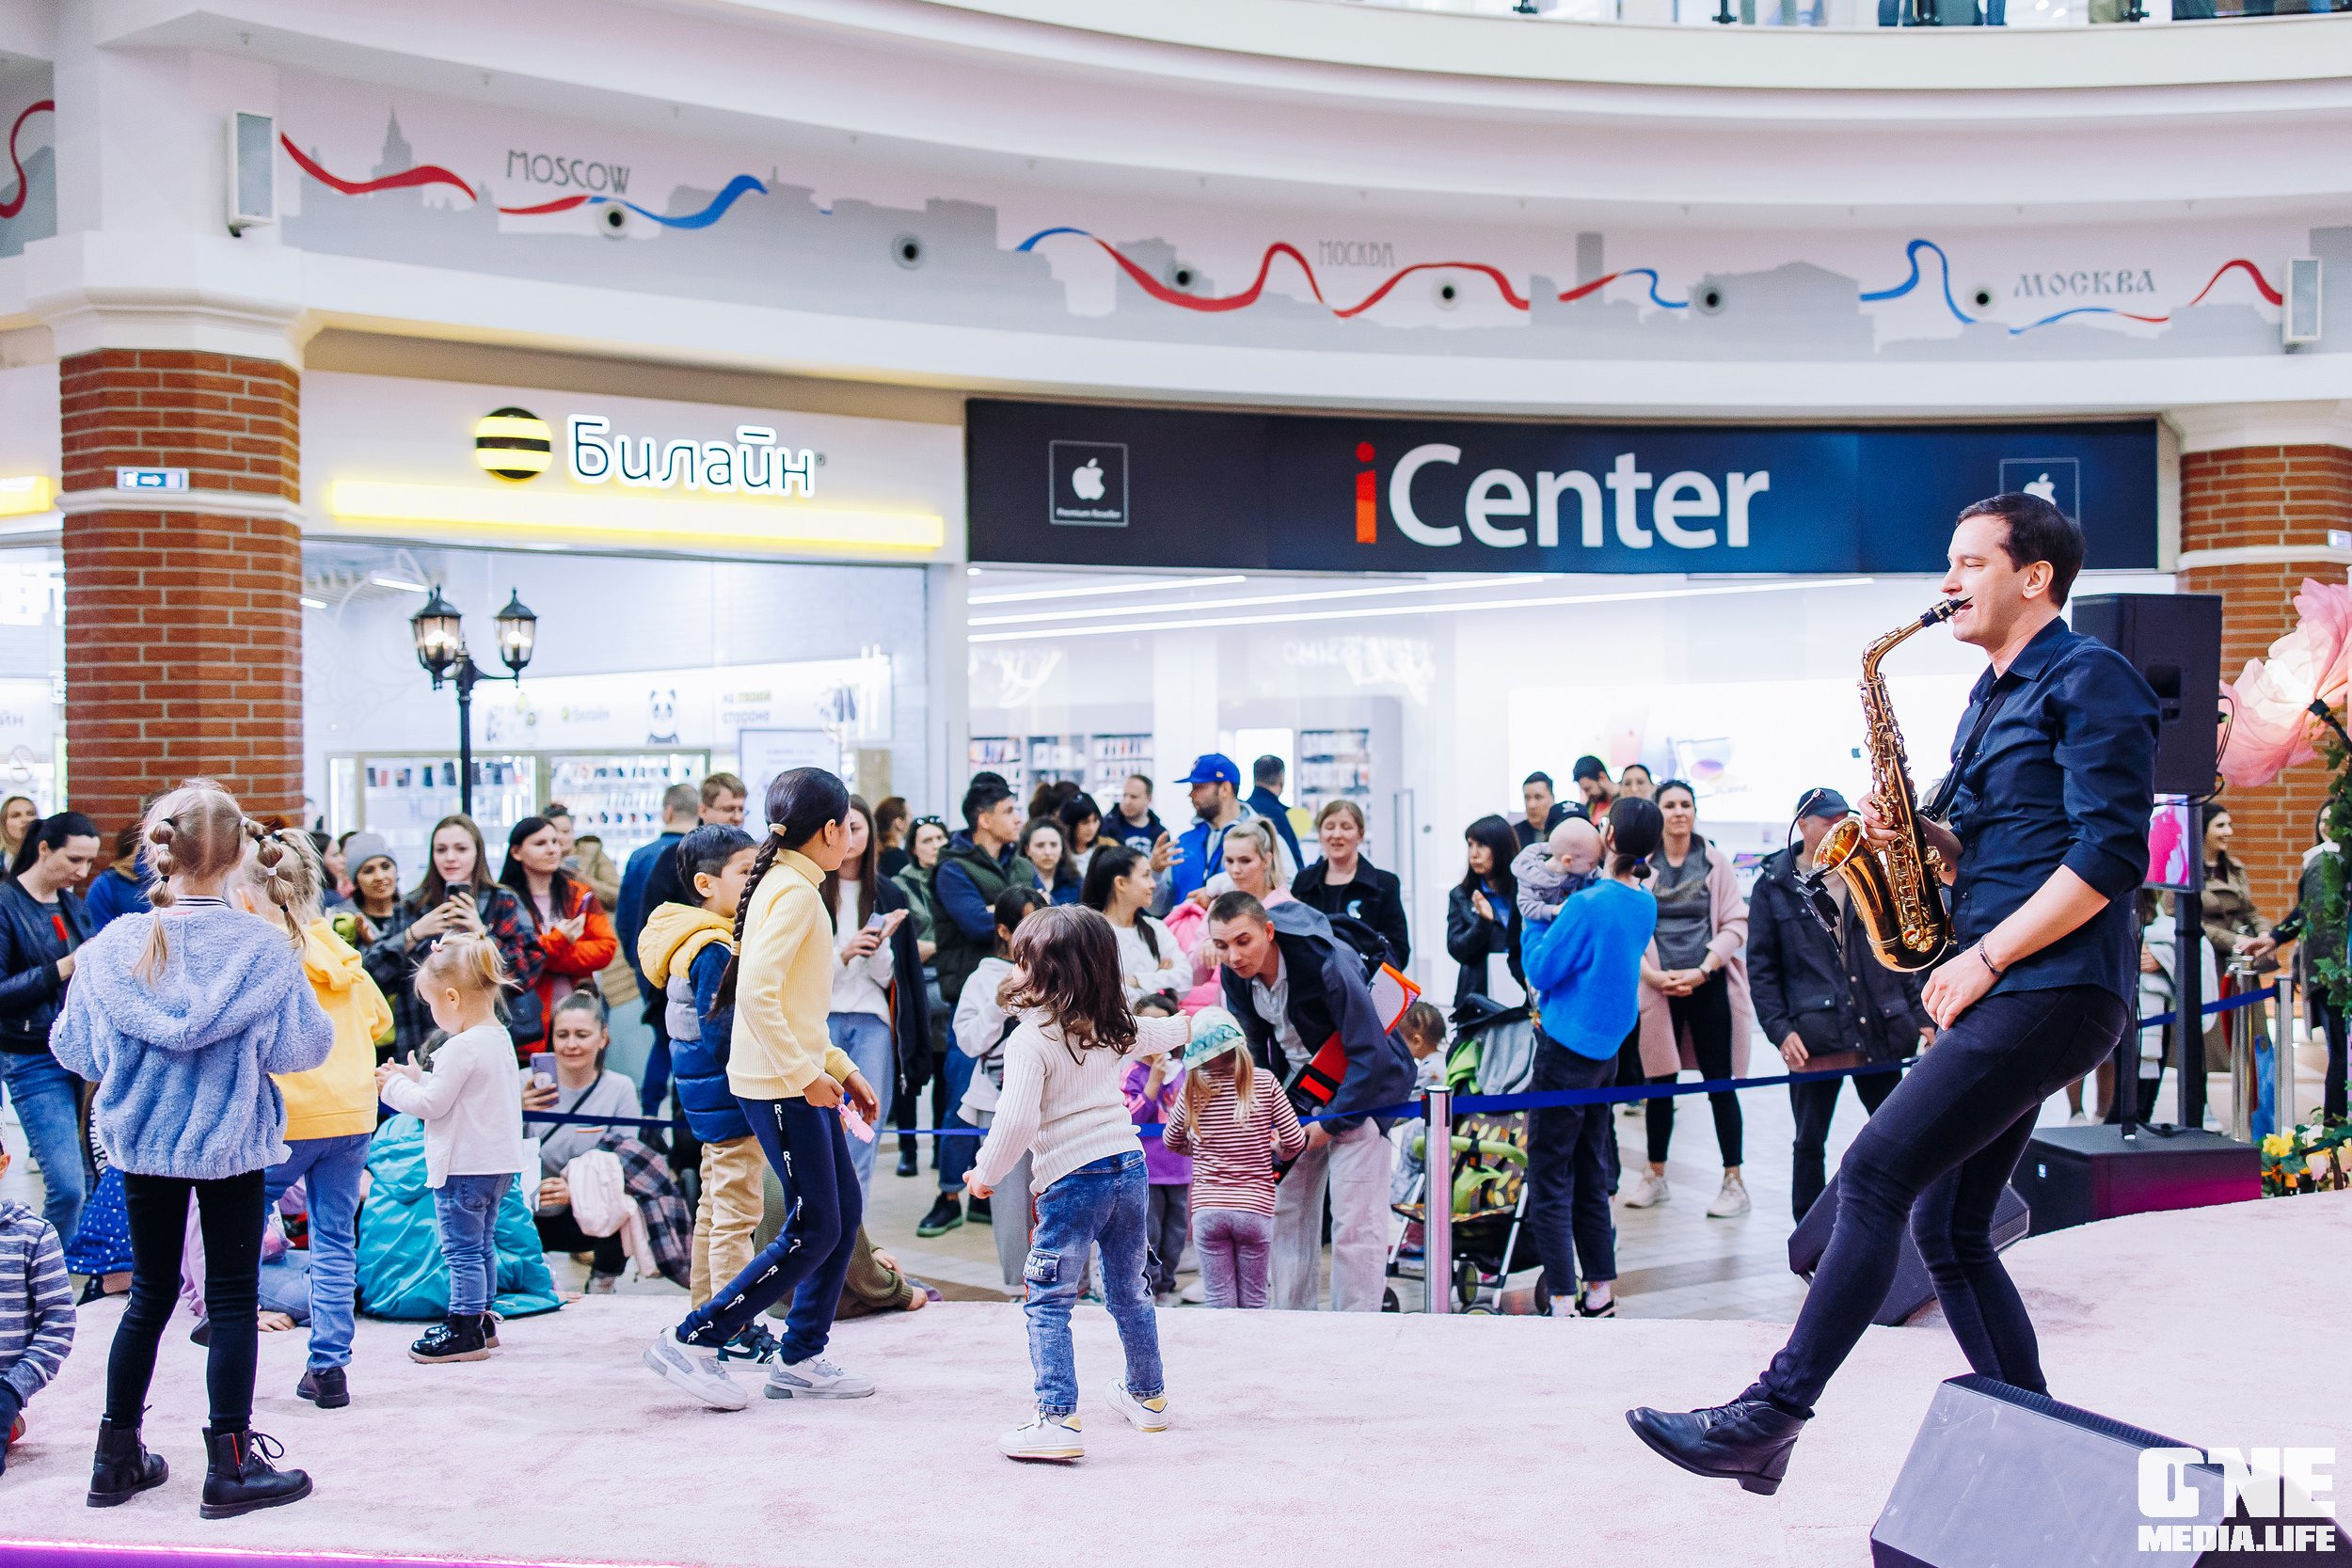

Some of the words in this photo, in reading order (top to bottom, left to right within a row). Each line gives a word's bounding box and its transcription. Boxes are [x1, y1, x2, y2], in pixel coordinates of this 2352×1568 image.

[506, 149, 630, 194] MOSCOW
[2013, 268, 2155, 297] МОСКВА
[566, 413, 816, 498] Билайн
[1355, 441, 1770, 549] iCenter
